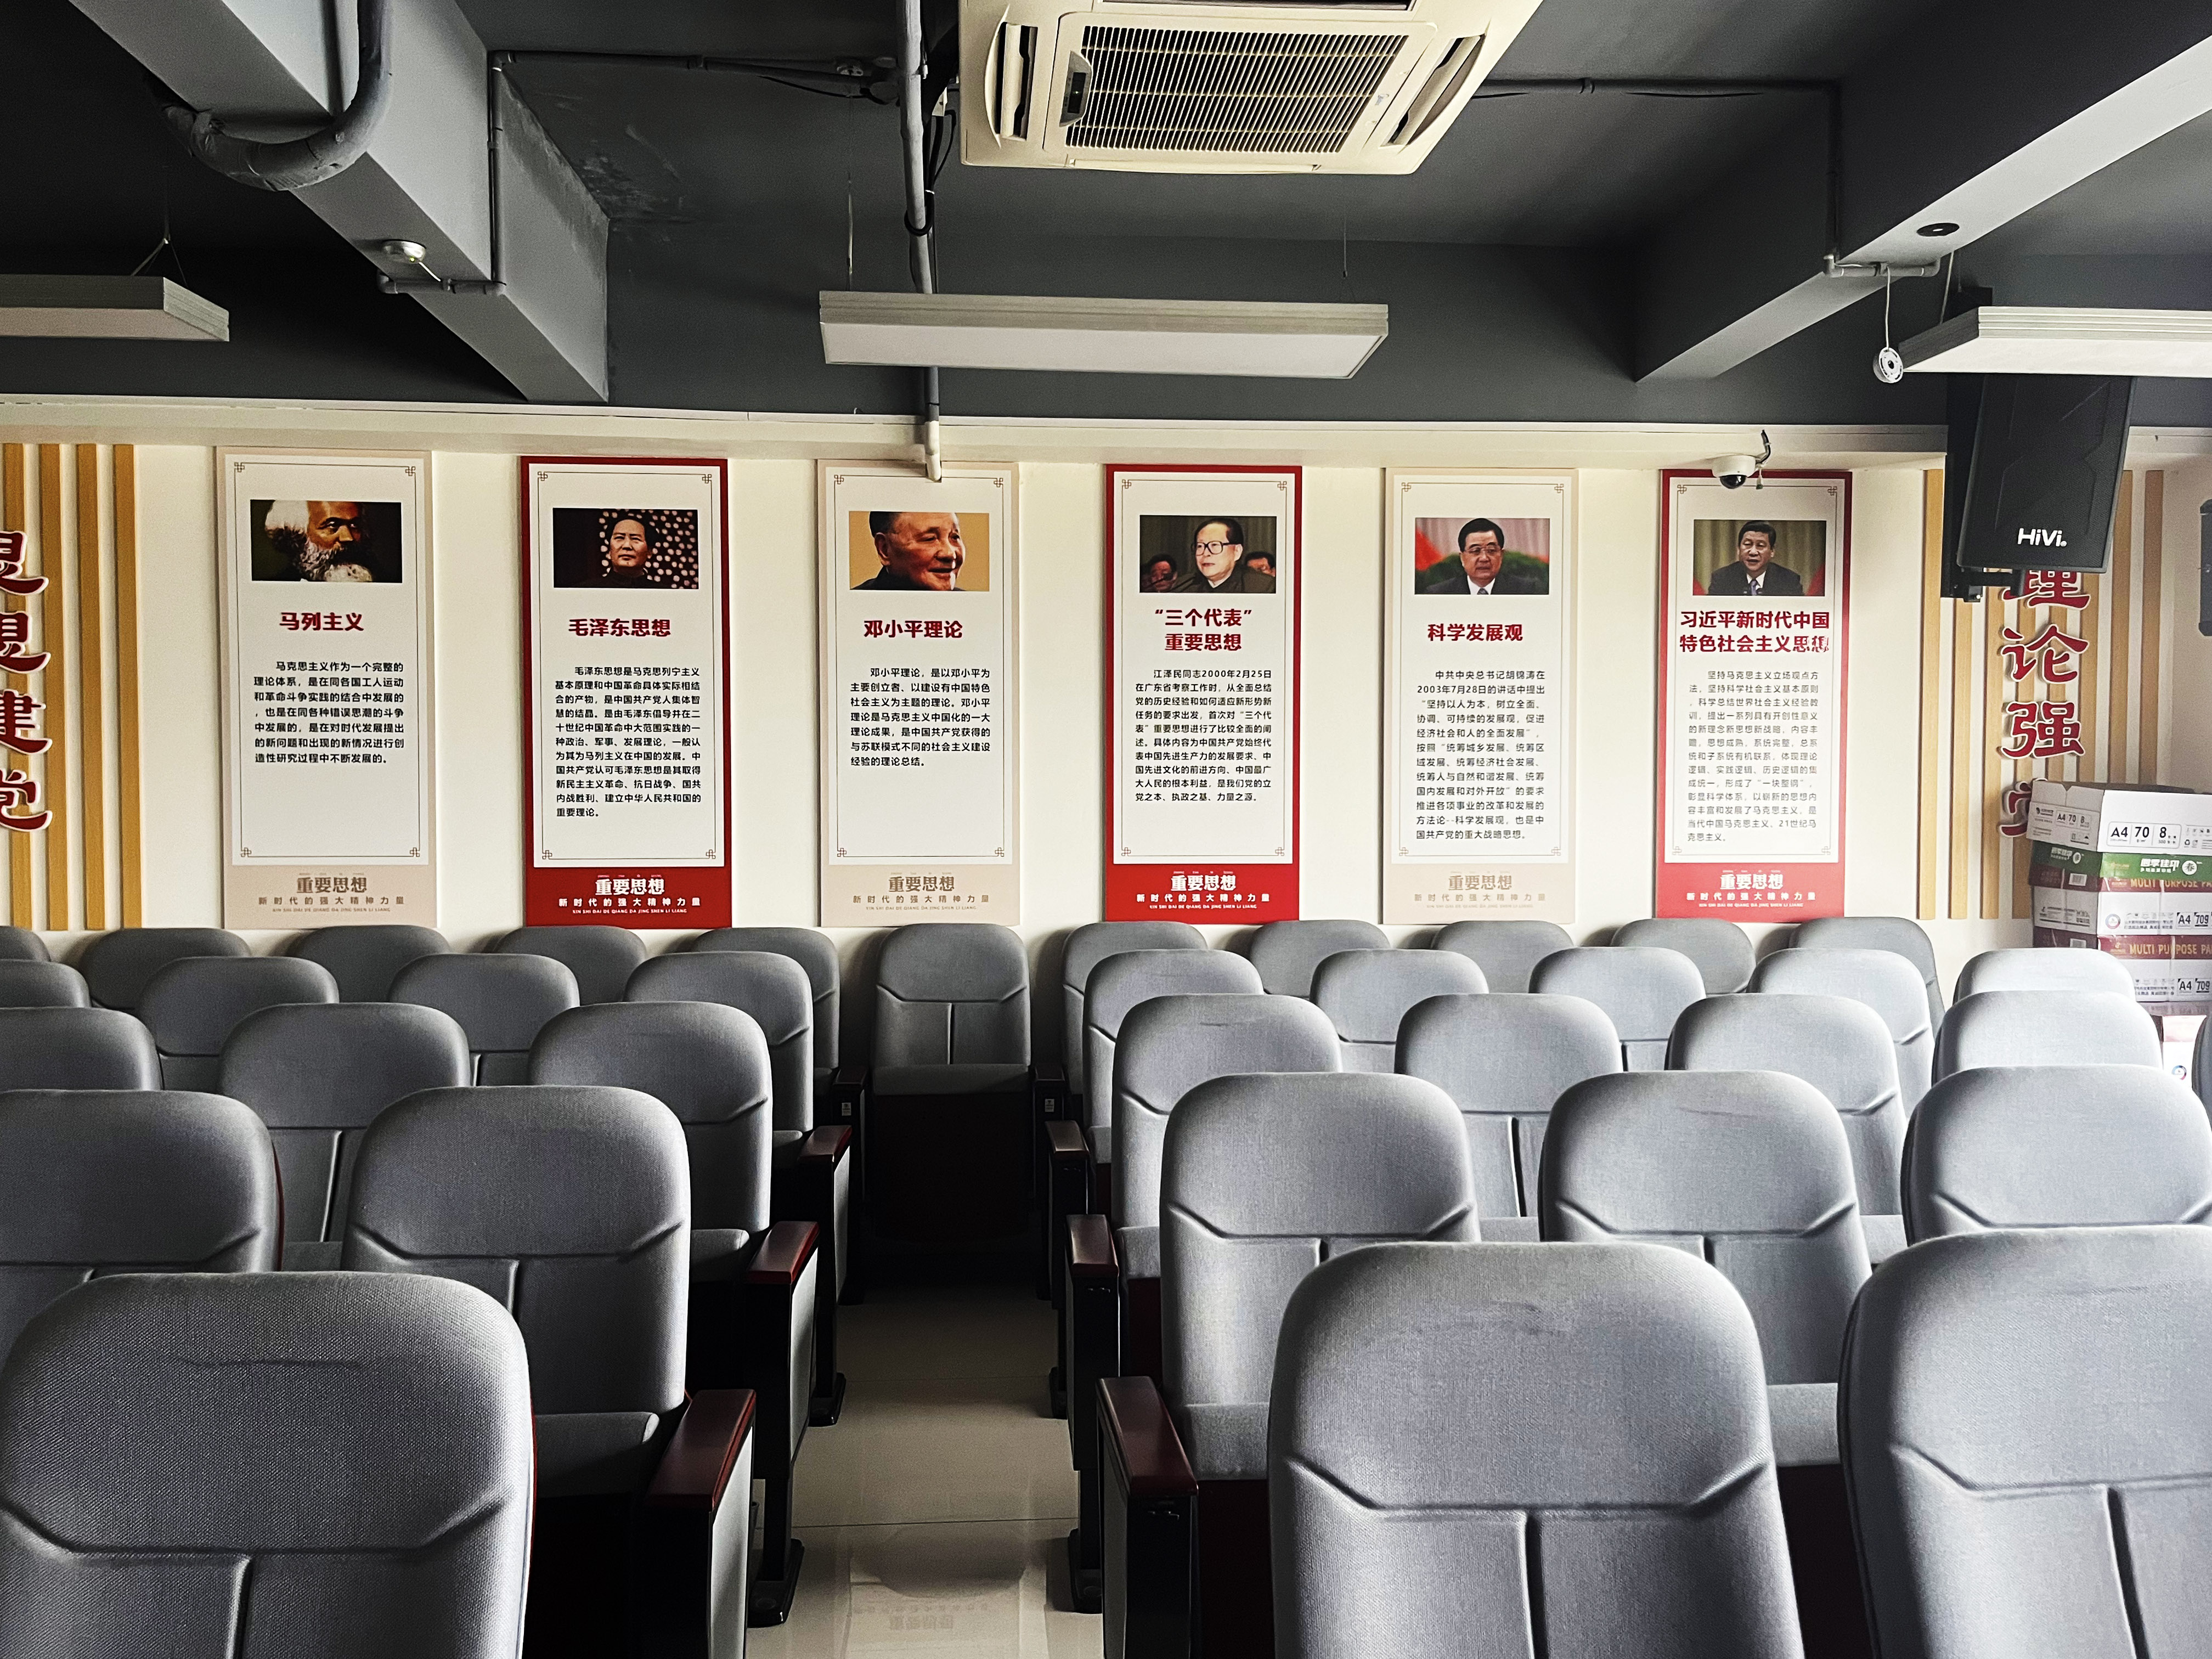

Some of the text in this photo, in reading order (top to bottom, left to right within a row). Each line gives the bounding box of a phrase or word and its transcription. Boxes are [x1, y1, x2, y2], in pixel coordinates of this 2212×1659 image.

[279, 612, 364, 631] 马列主义
[1155, 608, 1252, 627] “三个代表”
[1680, 610, 1830, 629] 习近平新时代中国
[568, 618, 672, 637] 毛泽东思想
[863, 619, 963, 639] 邓小平理论
[1427, 623, 1523, 642] 科学发展观
[1164, 633, 1242, 651] 重要思想
[1679, 634, 1829, 653] 特色社会主义思想
[275, 661, 404, 673] 马克思主义作为一个完整的
[574, 667, 700, 676] 毛泽东思想是马克思列宁主义
[870, 668, 990, 679] 邓小平理论，是以邓小平为
[1153, 669, 1271, 679] 江泽民同志2000年2月25日
[1435, 670, 1545, 680] 中共中央总书记胡锦涛在
[1708, 670, 1819, 680] 坚持马克思主义立场观点方
[253, 676, 404, 687] 理论体系，是在同各国工人运动
[555, 680, 700, 691] 基本原理和中国革命具体实际相结
[850, 682, 990, 693] 主要创立者、以建设有中国特色
[1135, 683, 1272, 692] 在广东省考察工作时，从全面总结
[1417, 685, 1545, 695] 2003年7月28日的讲话中提出
[254, 691, 404, 703] 和革命斗争实践的结合中发展的
[555, 695, 700, 704] 合的产物，是中国共产党人集体智
[1135, 697, 1272, 706] 党的历史经验和如何适应新形势新
[850, 697, 991, 708] 社会主义为主题的理论。邓小平
[850, 712, 991, 723] 理论是马克思主义中国化的一大
[255, 722, 404, 733] 中发展的，是在对时代发展提出
[555, 723, 701, 733] 十世纪中国革命中大范围实践的一
[850, 727, 990, 737] 理论成果，是中国共产党获得的
[255, 737, 404, 748] 的新问题和出现的新情况进行创
[850, 742, 991, 752] 与苏联模式不同的社会主义建设
[1135, 738, 1272, 747] 述。具体内容为中国共产党始终代
[255, 753, 387, 764] 造性研究过程中不断发展的。
[555, 751, 701, 761] 为其为马列主义在中国的发展。中
[1135, 752, 1271, 761] 表中国先进生产力的发展要求、中
[850, 757, 924, 766] 经验的理论总结。
[556, 765, 701, 775] 国共产党认可毛泽东思想是其取得
[1135, 765, 1272, 774] 国先进文化的前进方向、中国最广
[556, 779, 701, 789] 新民主主义革命、抗日战争、国共
[1135, 778, 1272, 788] 大人民的根本利益，是我们党的立
[556, 793, 701, 803] 内战胜利、建立中华人民共和国的
[1416, 801, 1544, 810] 推进各项事业的改革和发展的
[556, 808, 599, 817] 重要理论。
[2111, 826, 2167, 838] A4 70 8
[296, 877, 367, 894] 重要思想
[595, 878, 665, 895] 重要思想
[888, 876, 955, 893] 重要思想
[1170, 874, 1237, 891] 重要思想
[1448, 875, 1512, 891] 重要思想
[1720, 873, 1784, 890] 重要思想
[2160, 879, 2198, 888] URPOSE
[258, 896, 404, 905] 新时代的强大精神力量
[853, 895, 989, 904] 新时代的强大精神力量
[1136, 893, 1269, 902] 新时代的强大精神力量
[1414, 893, 1545, 902] 新时代的强大精神力量
[1686, 891, 1816, 901] 新时代的强大精神力量
[558, 897, 701, 907] 新时代的强大精神力量
[2178, 915, 2191, 924] A4
[2129, 943, 2212, 955] MULTI PUPOSE PA
[2179, 980, 2192, 990] A4
